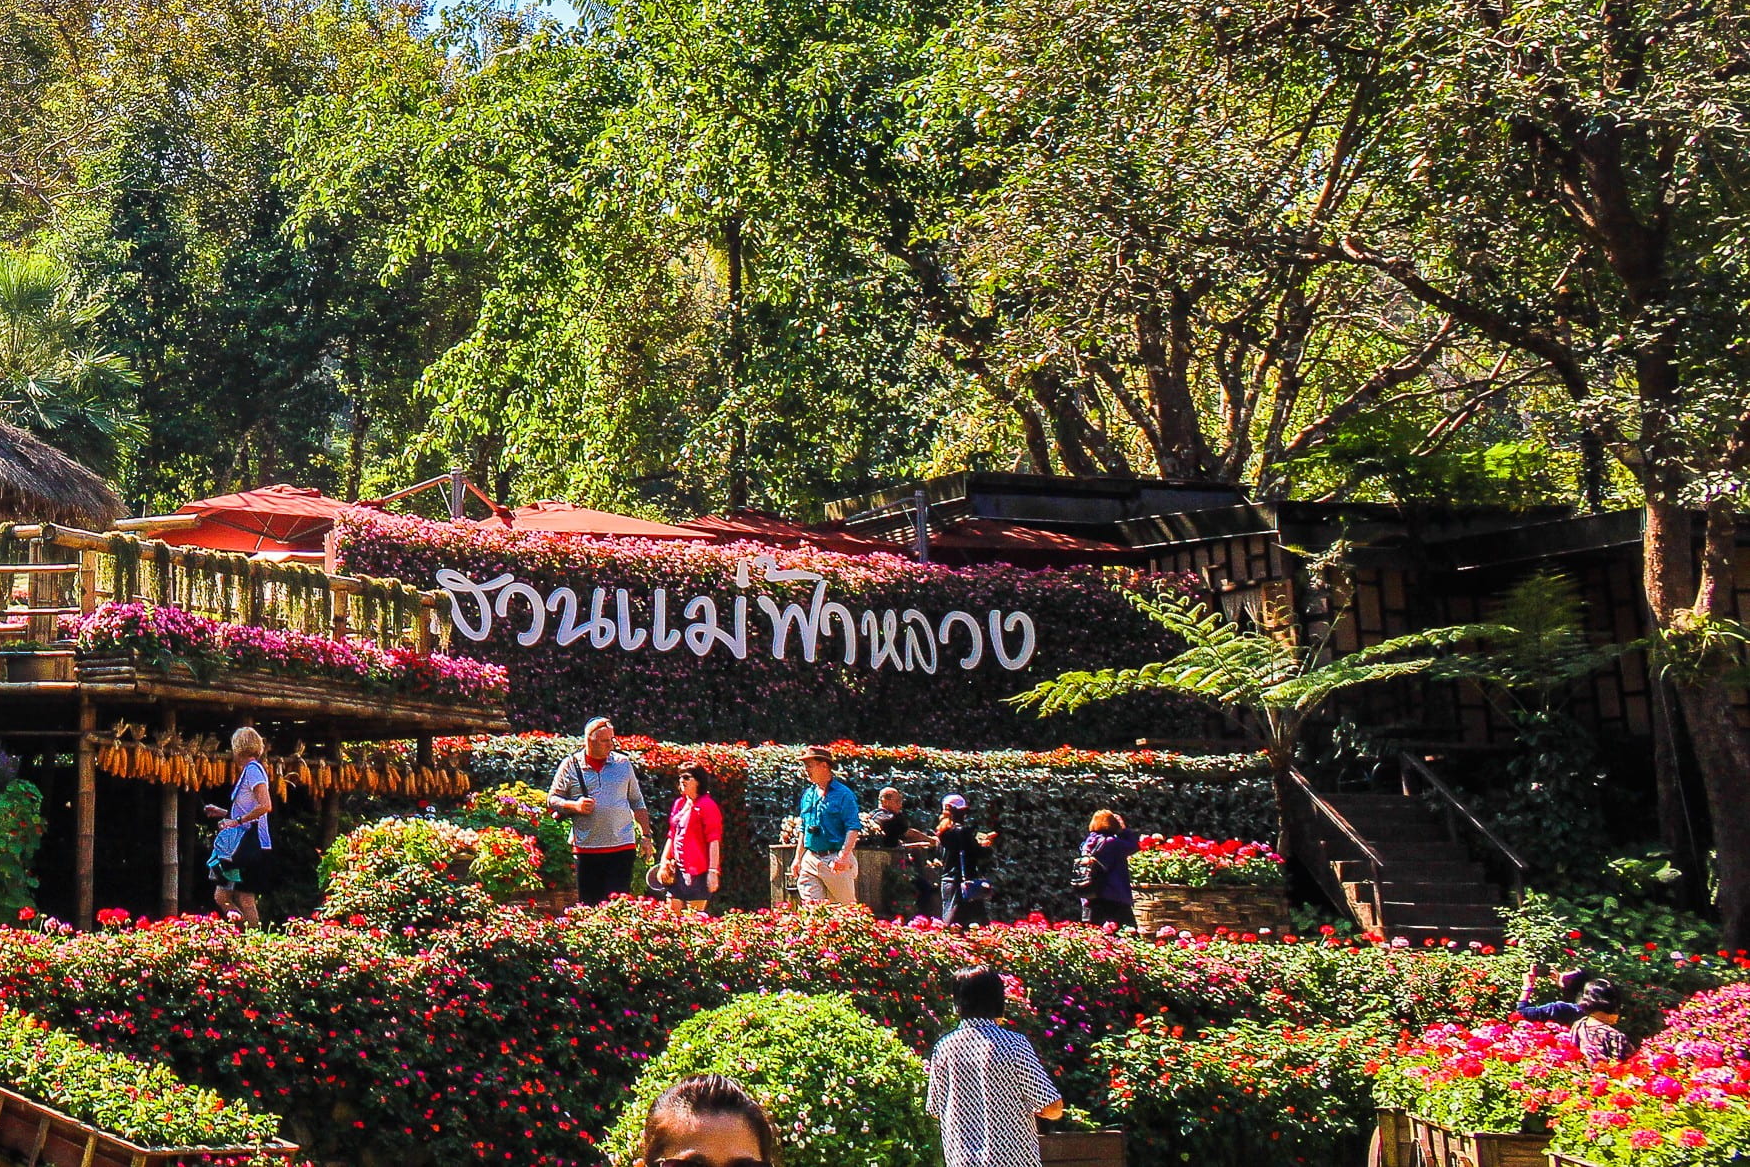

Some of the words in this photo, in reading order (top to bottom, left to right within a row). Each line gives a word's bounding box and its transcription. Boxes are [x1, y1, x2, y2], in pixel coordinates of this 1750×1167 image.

[436, 555, 1036, 675] สวนแม่ฟ้าหลวง
